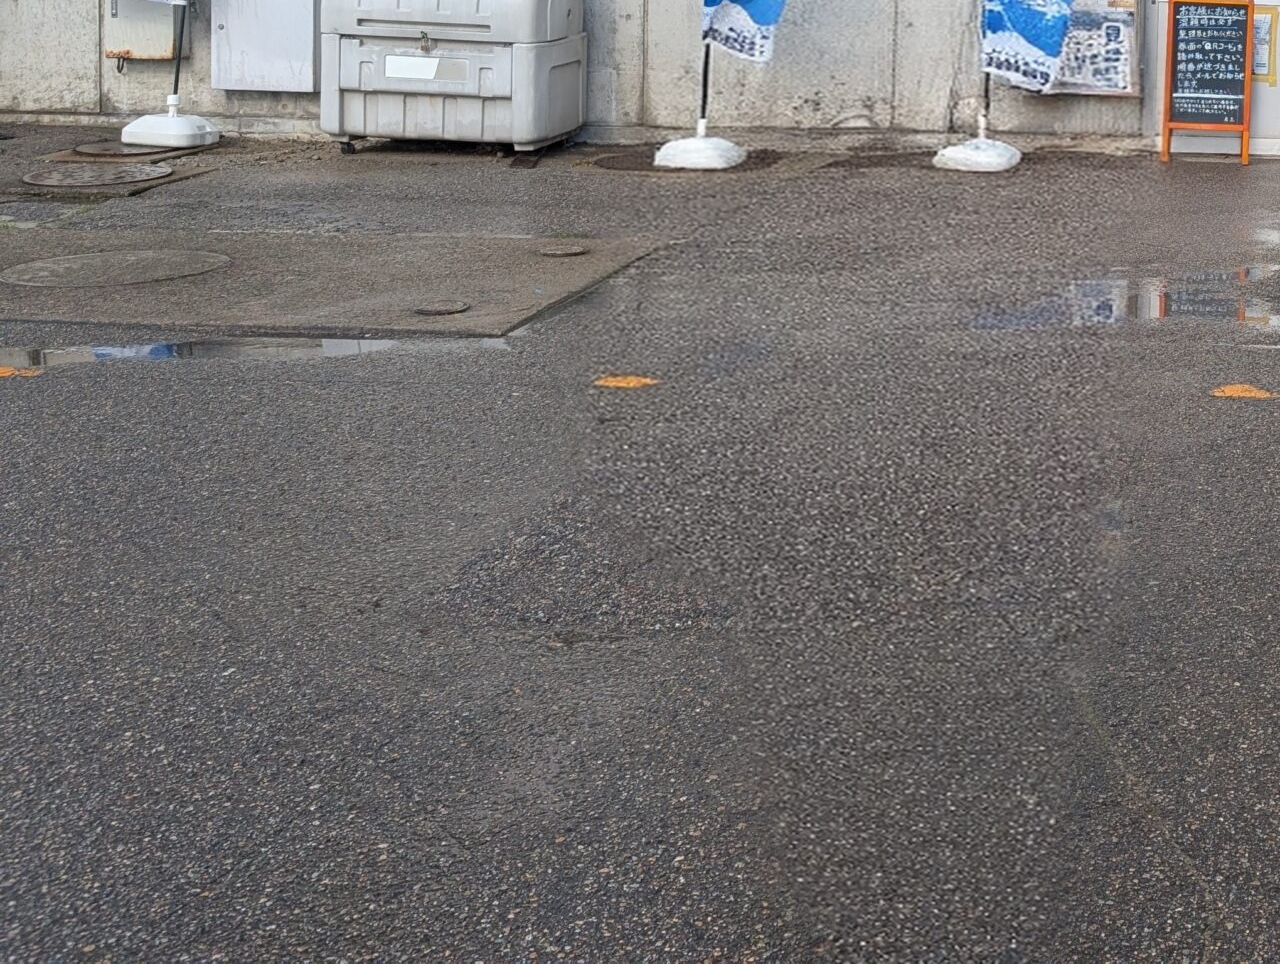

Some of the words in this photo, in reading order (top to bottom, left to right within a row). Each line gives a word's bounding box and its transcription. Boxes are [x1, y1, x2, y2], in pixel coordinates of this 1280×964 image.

[1179, 5, 1246, 17] お客様にお知らせ
